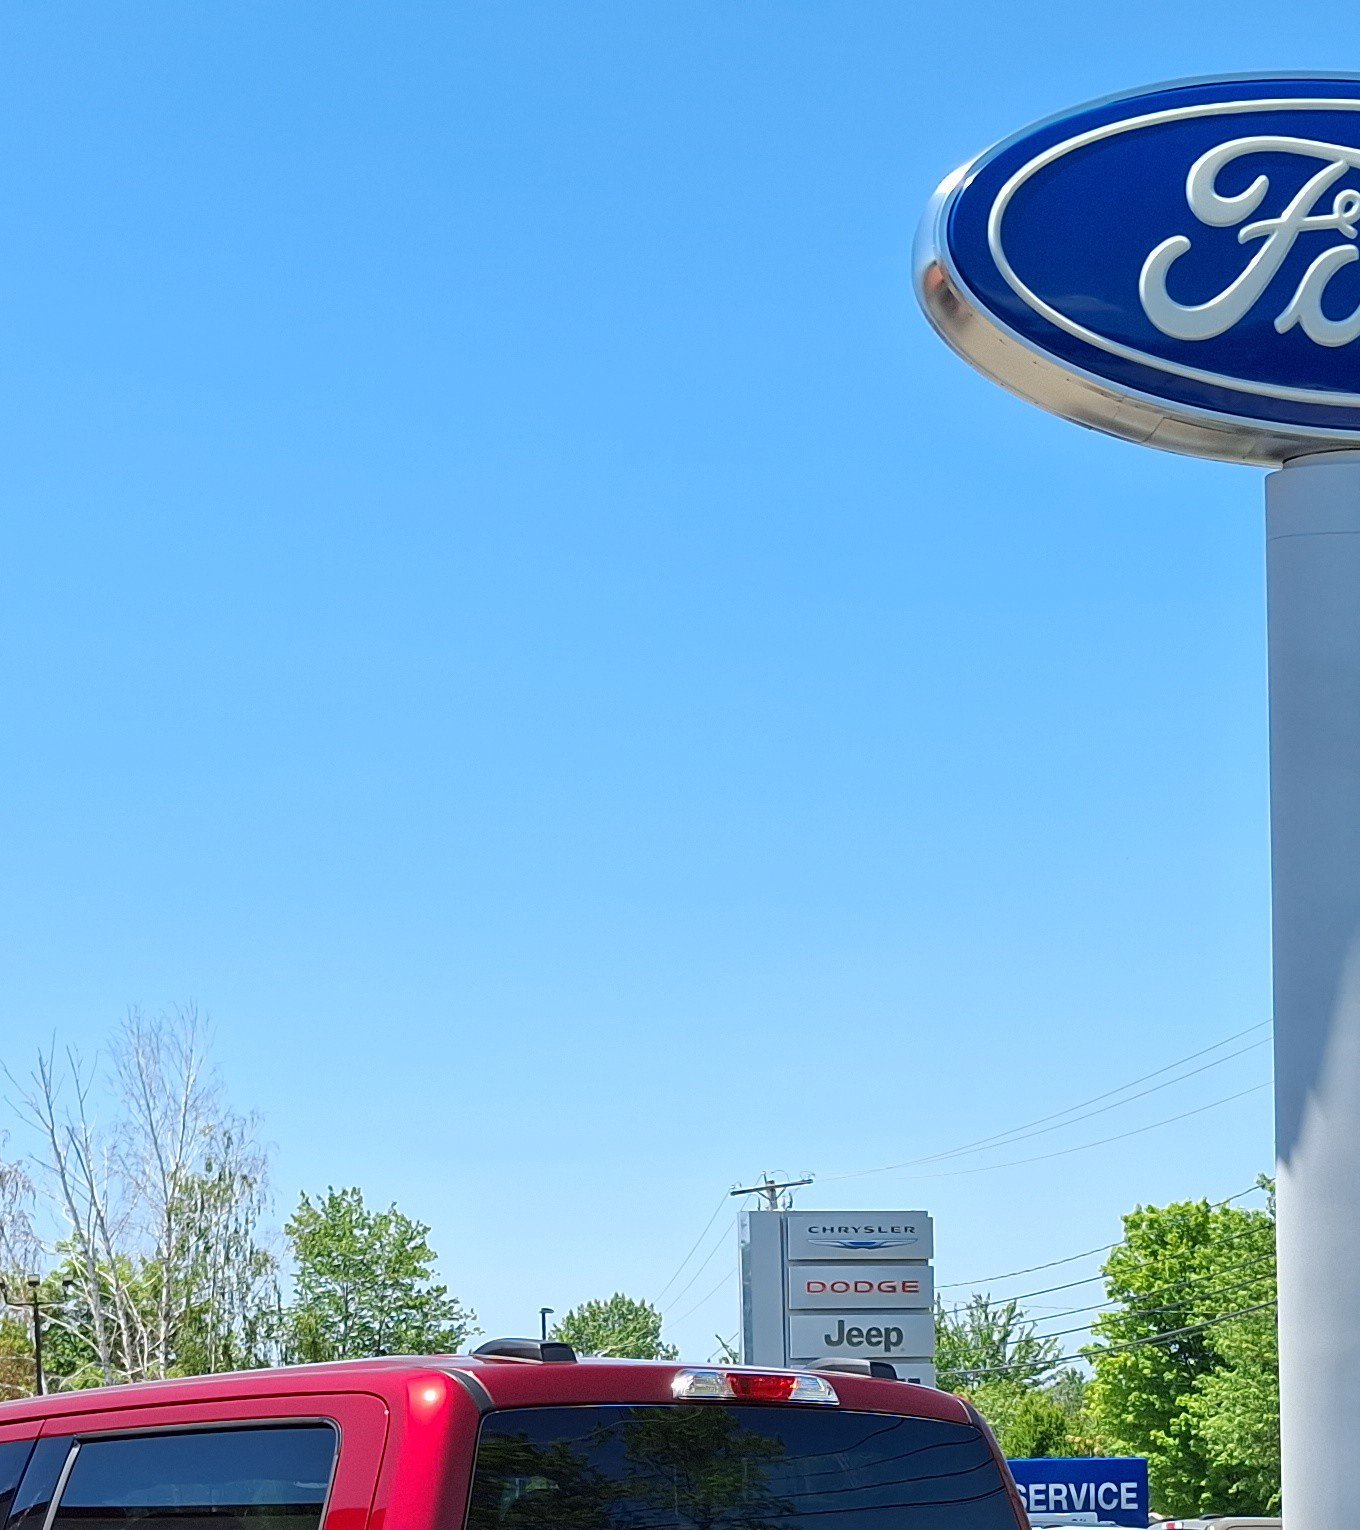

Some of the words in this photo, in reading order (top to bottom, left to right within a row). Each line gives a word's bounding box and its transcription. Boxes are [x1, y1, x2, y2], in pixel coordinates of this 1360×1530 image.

[808, 1225, 916, 1234] CHRYSLER
[806, 1280, 919, 1294] DODGE
[824, 1319, 904, 1352] Jeep
[1016, 1482, 1139, 1512] SERVICE
